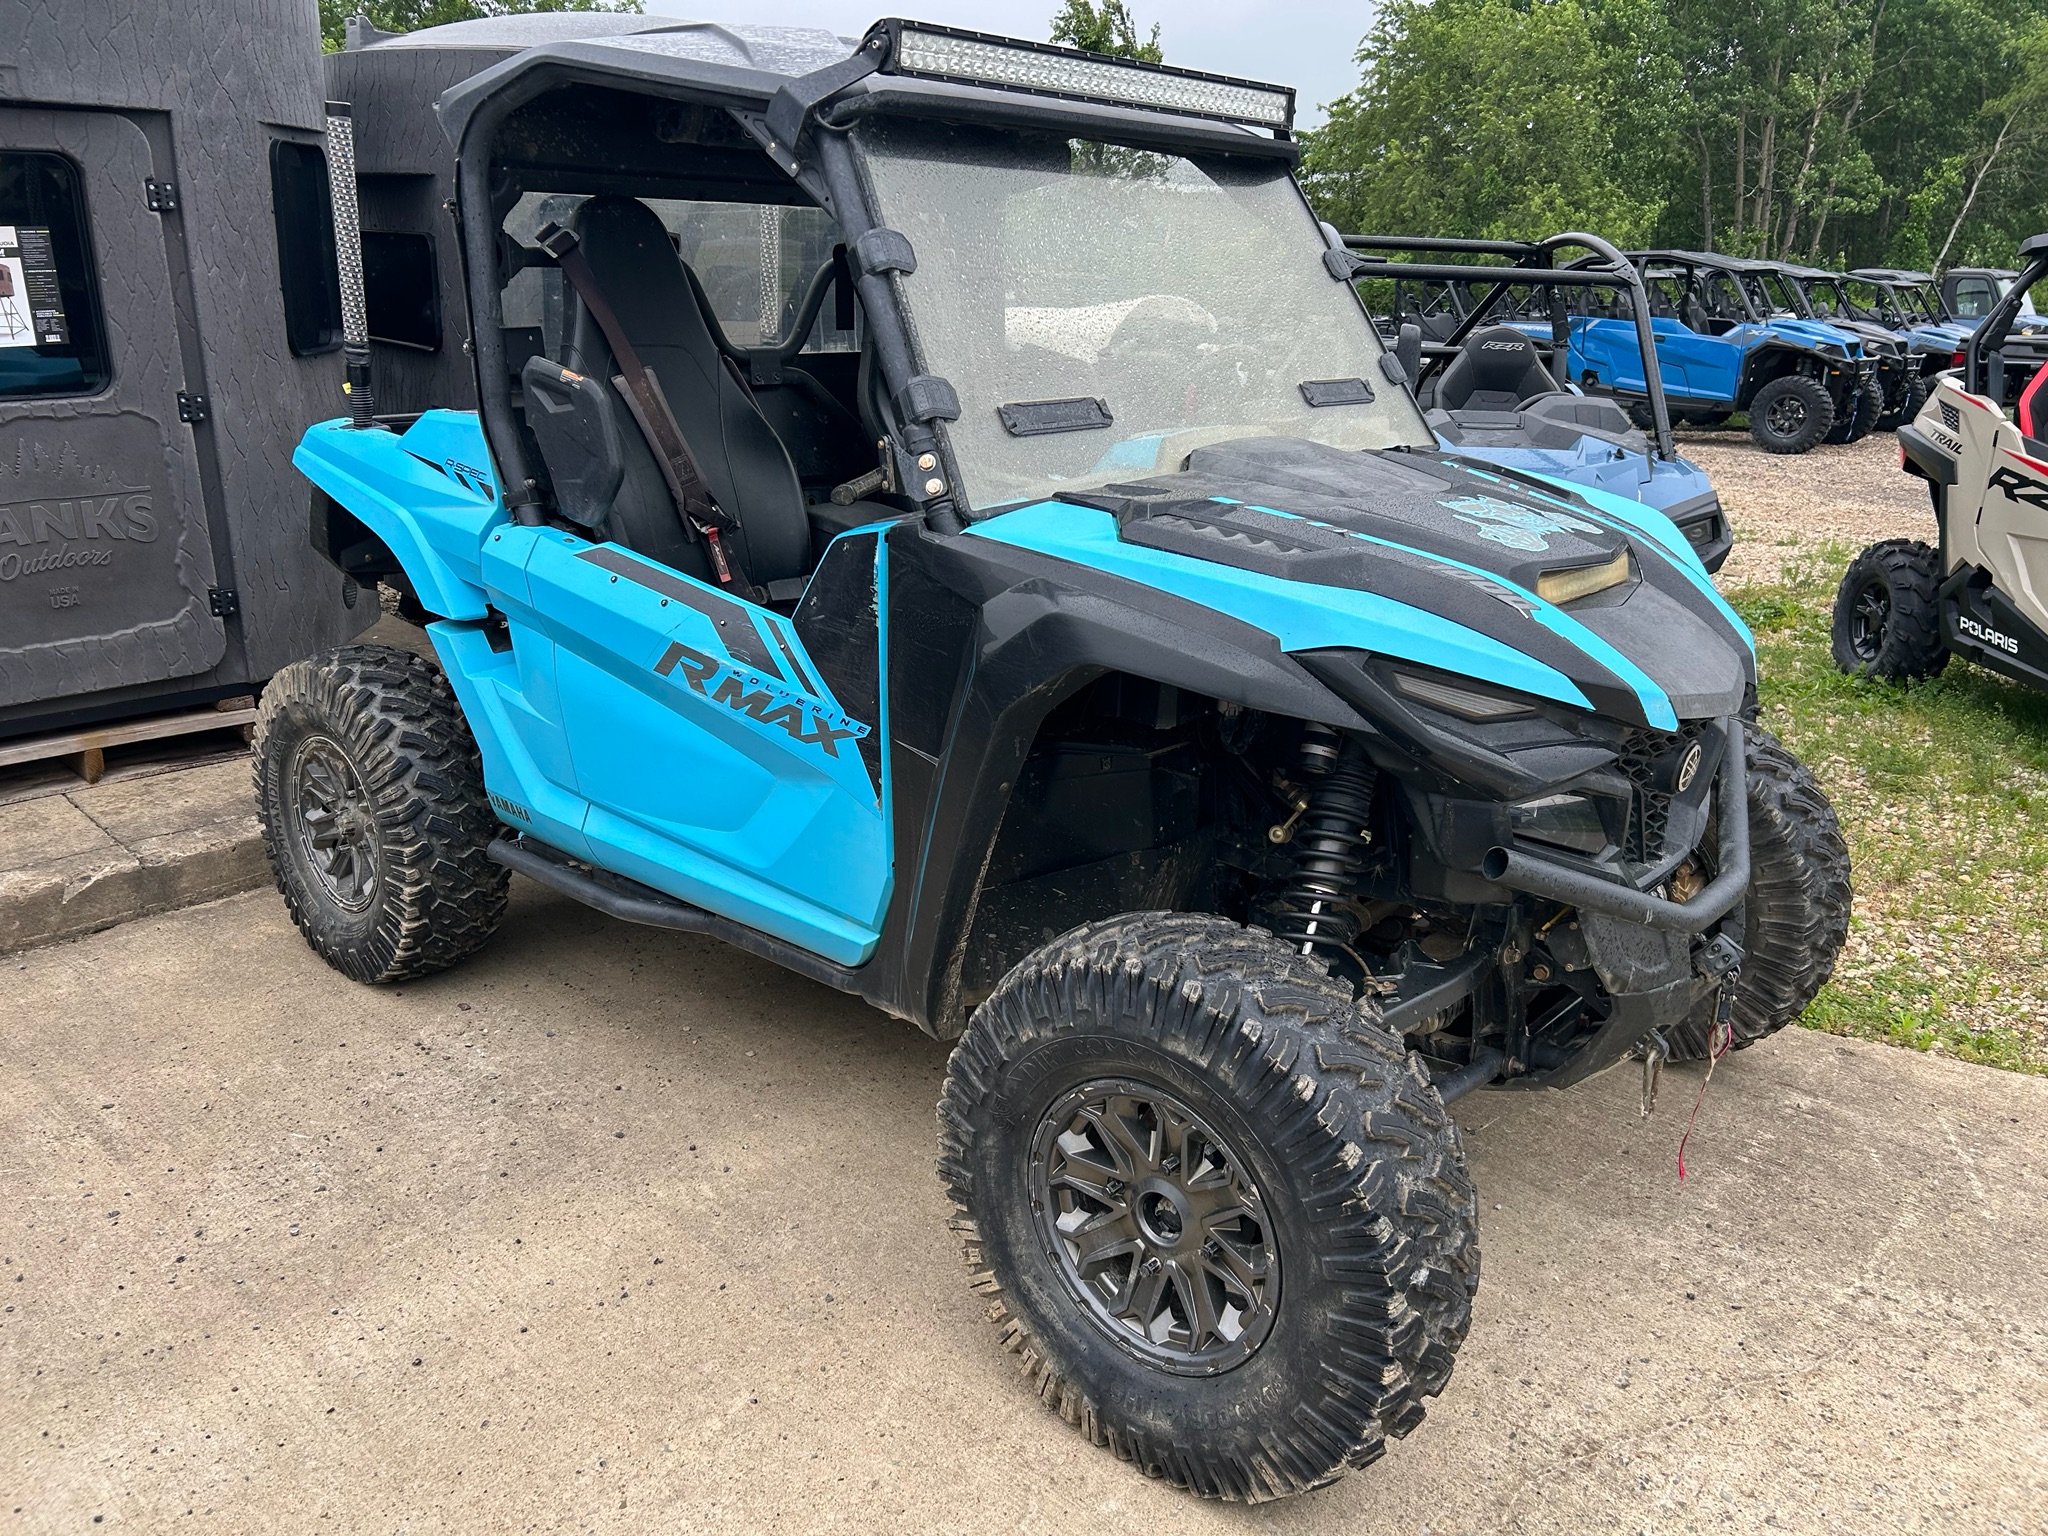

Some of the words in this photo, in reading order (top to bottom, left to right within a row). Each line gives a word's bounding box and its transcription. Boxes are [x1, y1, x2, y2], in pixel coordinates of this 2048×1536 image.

[1481, 341, 1525, 351] RZR
[1931, 428, 1963, 456] TRAIL
[0, 543, 113, 581] Outdoors
[50, 593, 80, 609] USA
[1960, 616, 2018, 654] POLARIS
[653, 640, 859, 760] RMAX
[732, 669, 868, 735] WOLVERINE
[486, 791, 533, 825] YAMAHA
[1018, 1044, 1066, 1082] DIRT
